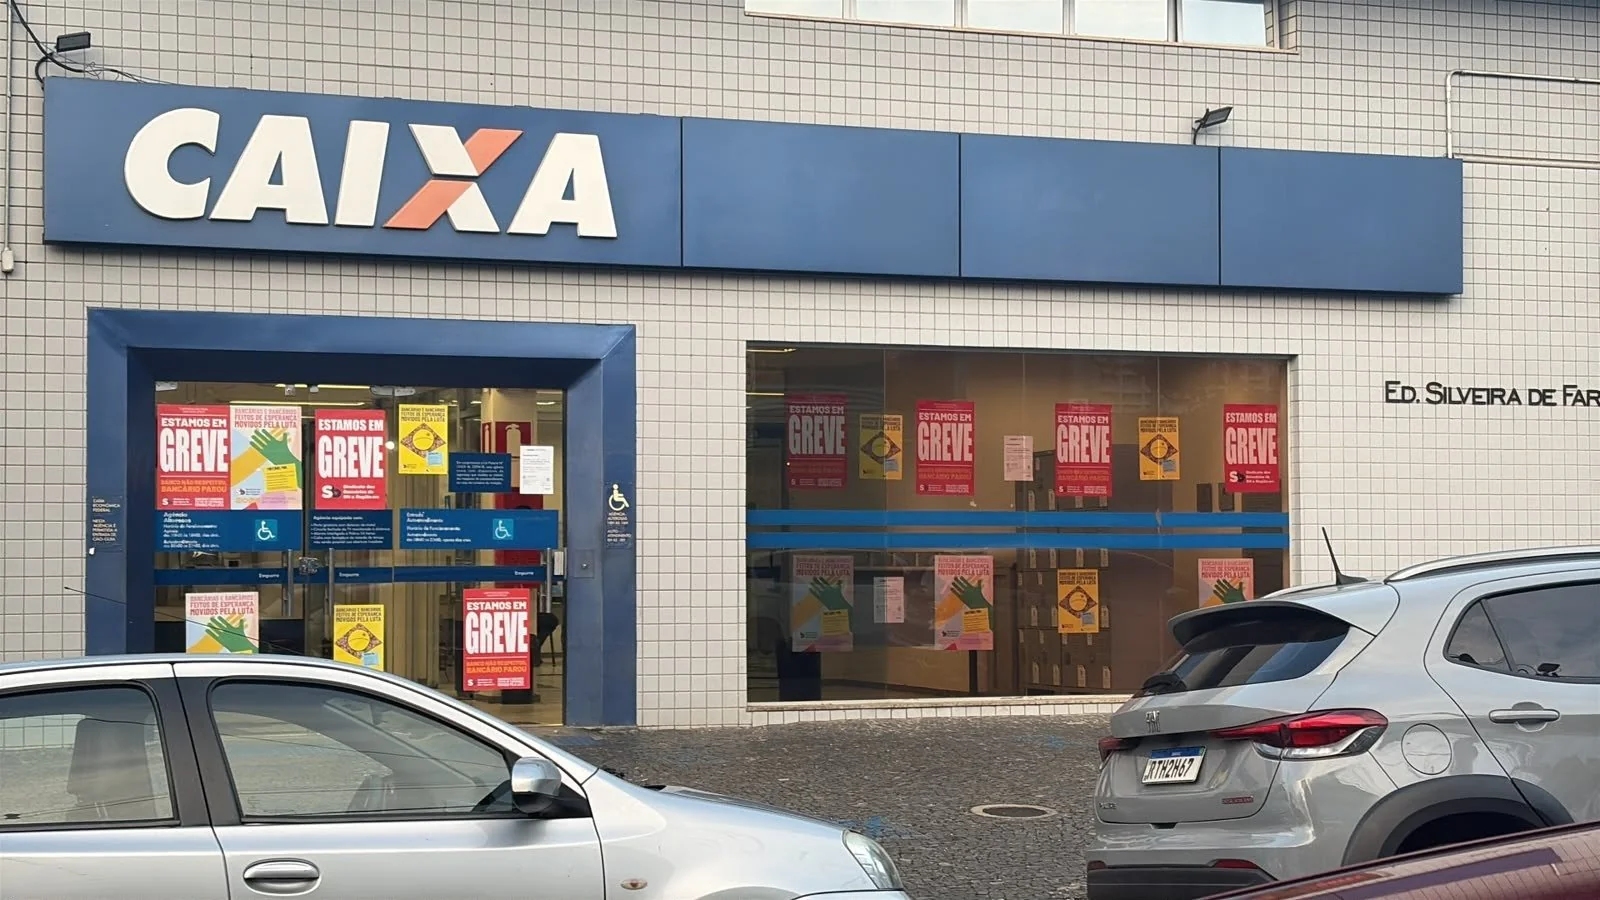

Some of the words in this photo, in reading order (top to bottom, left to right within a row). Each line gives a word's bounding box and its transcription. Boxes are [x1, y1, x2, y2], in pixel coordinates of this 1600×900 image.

[124, 107, 618, 239] CAIXA
[789, 405, 830, 414] ESTAMOS
[832, 406, 844, 414] EM
[1426, 382, 1522, 405] SILVEIRA
[1528, 388, 1557, 406] DE
[161, 418, 210, 427] ESTAMOS
[212, 418, 226, 427] EM
[318, 419, 367, 431] ESTAMOS
[369, 419, 384, 431] EM
[919, 413, 958, 421] ESTAMOS
[1226, 413, 1263, 423] ESTAMOS
[1265, 413, 1276, 423] EM
[160, 428, 228, 472] GREVE
[789, 415, 845, 455] GREVE
[918, 421, 972, 461] GREVE
[1057, 425, 1110, 463] GREVE
[1226, 427, 1277, 465] GREVE
[318, 435, 384, 478] GREVE
[467, 602, 511, 610] ESTAMOS
[513, 601, 526, 610] EM
[466, 611, 528, 654] GREVE
[1147, 758, 1194, 779] RTH2H67
